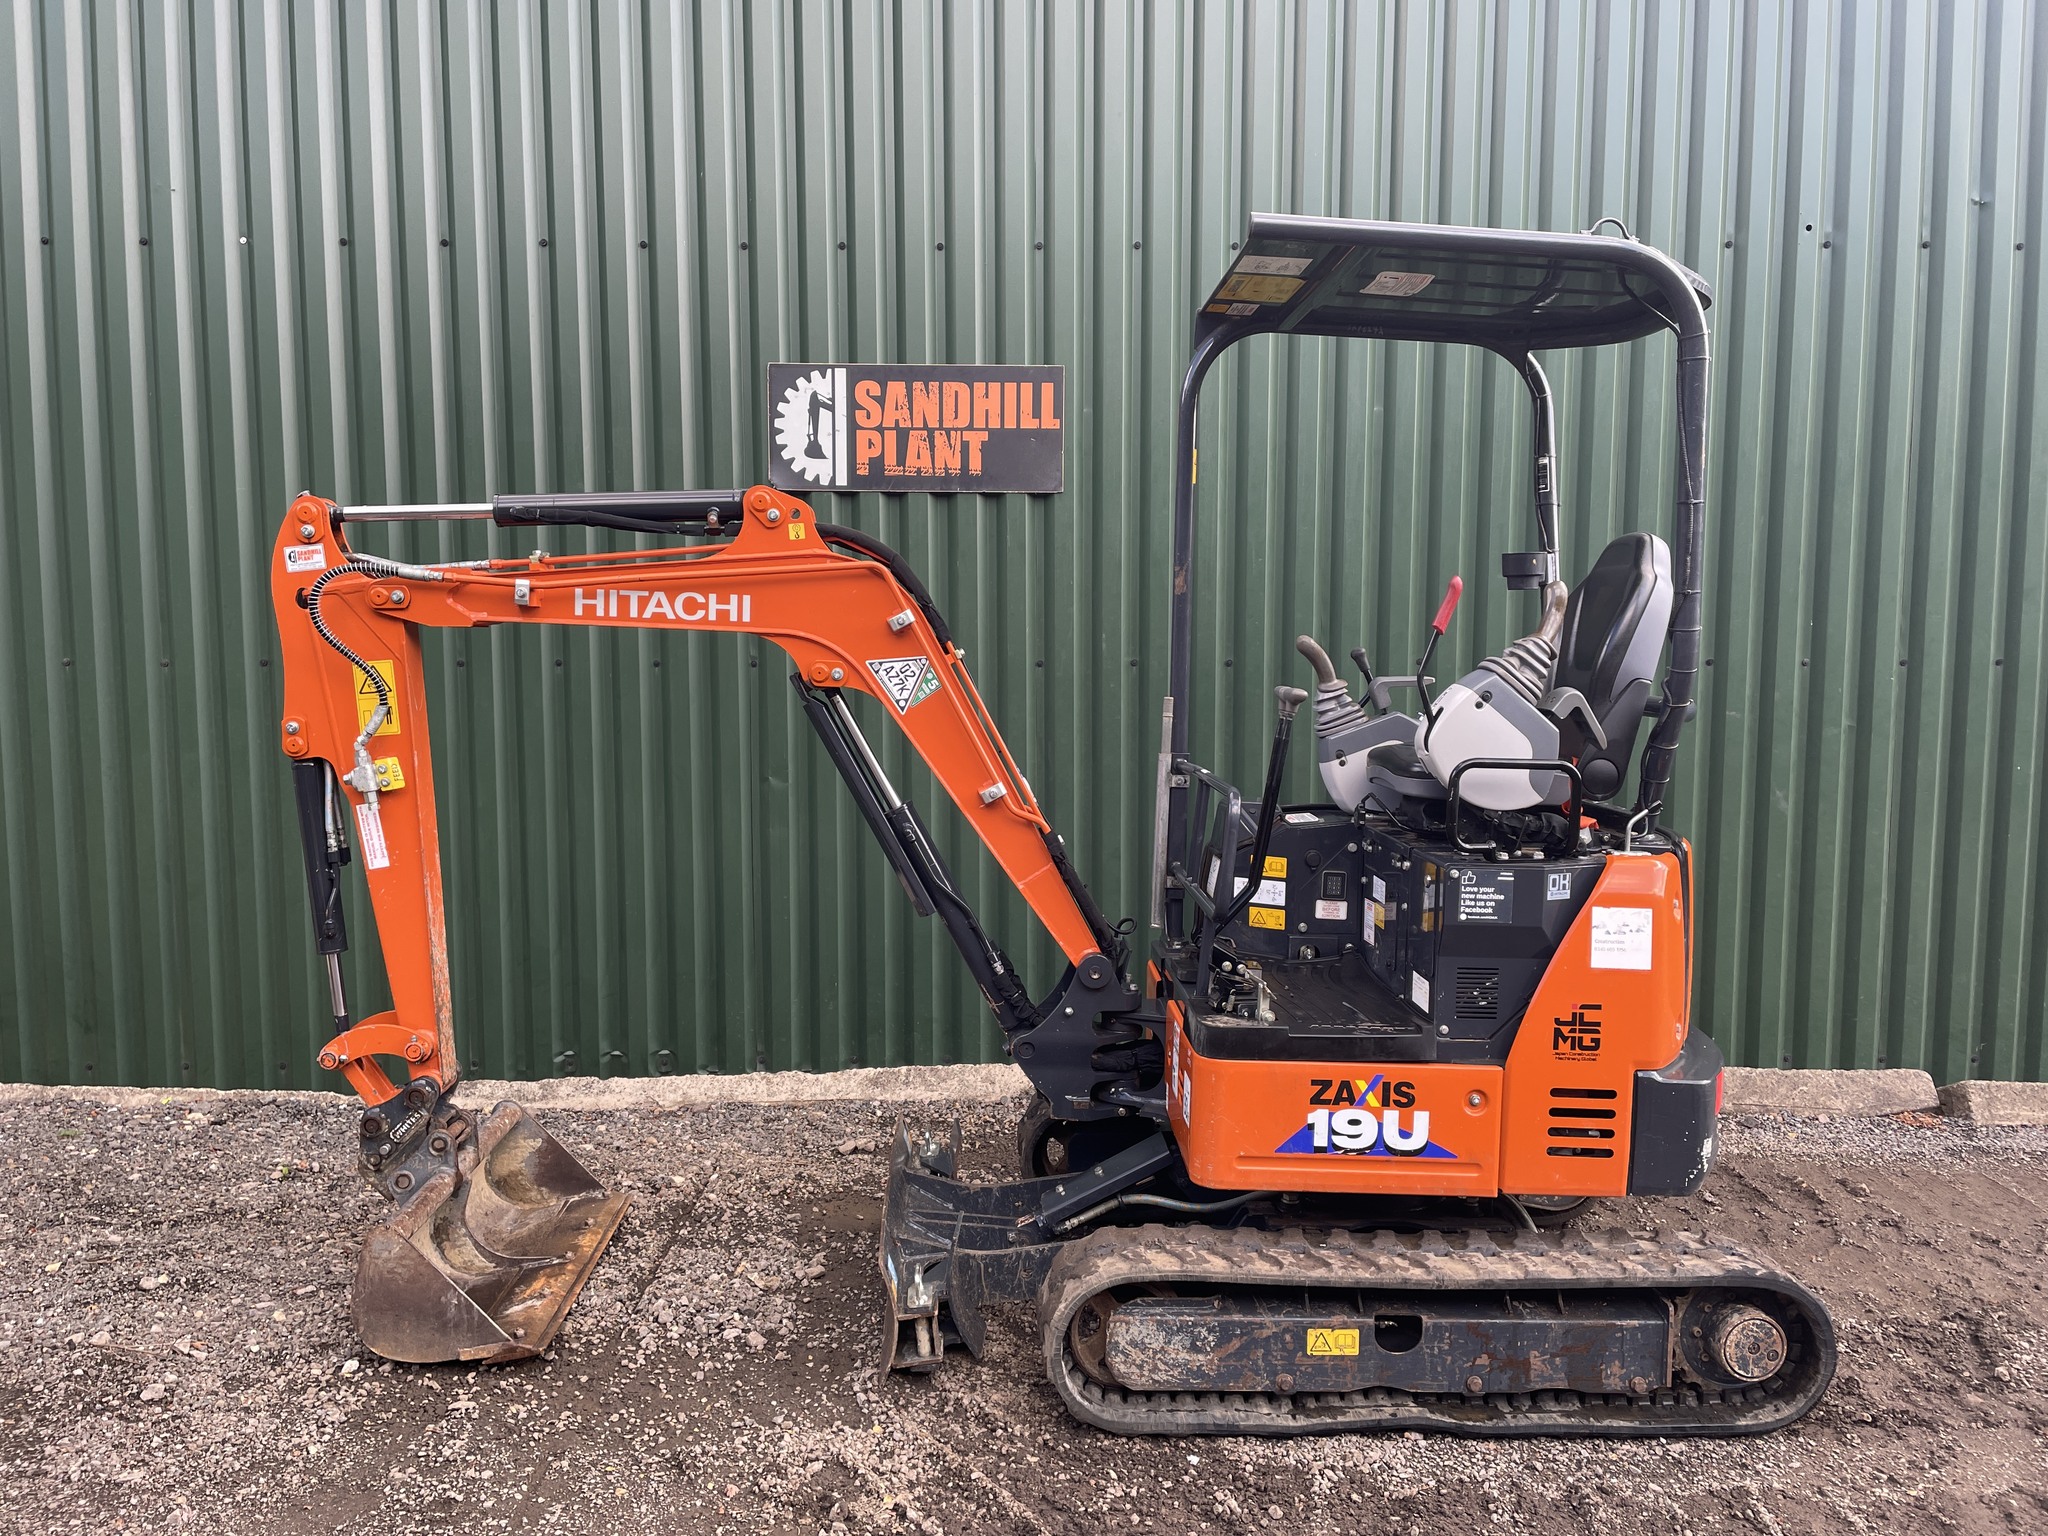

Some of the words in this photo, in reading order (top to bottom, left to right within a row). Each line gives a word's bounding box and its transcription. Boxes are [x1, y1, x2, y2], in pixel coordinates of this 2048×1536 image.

[854, 380, 1061, 430] SANDHILL
[855, 429, 989, 477] PLANT
[574, 587, 752, 623] HITACHI
[882, 665, 910, 697] AZ7K
[927, 679, 939, 690] 5
[1461, 885, 1478, 893] Love
[1549, 874, 1570, 890] OK
[1460, 906, 1493, 914] Facebook
[1309, 1074, 1416, 1108] ZAXIS
[394, 1111, 421, 1138] WHITES
[1307, 1108, 1430, 1156] 19U
